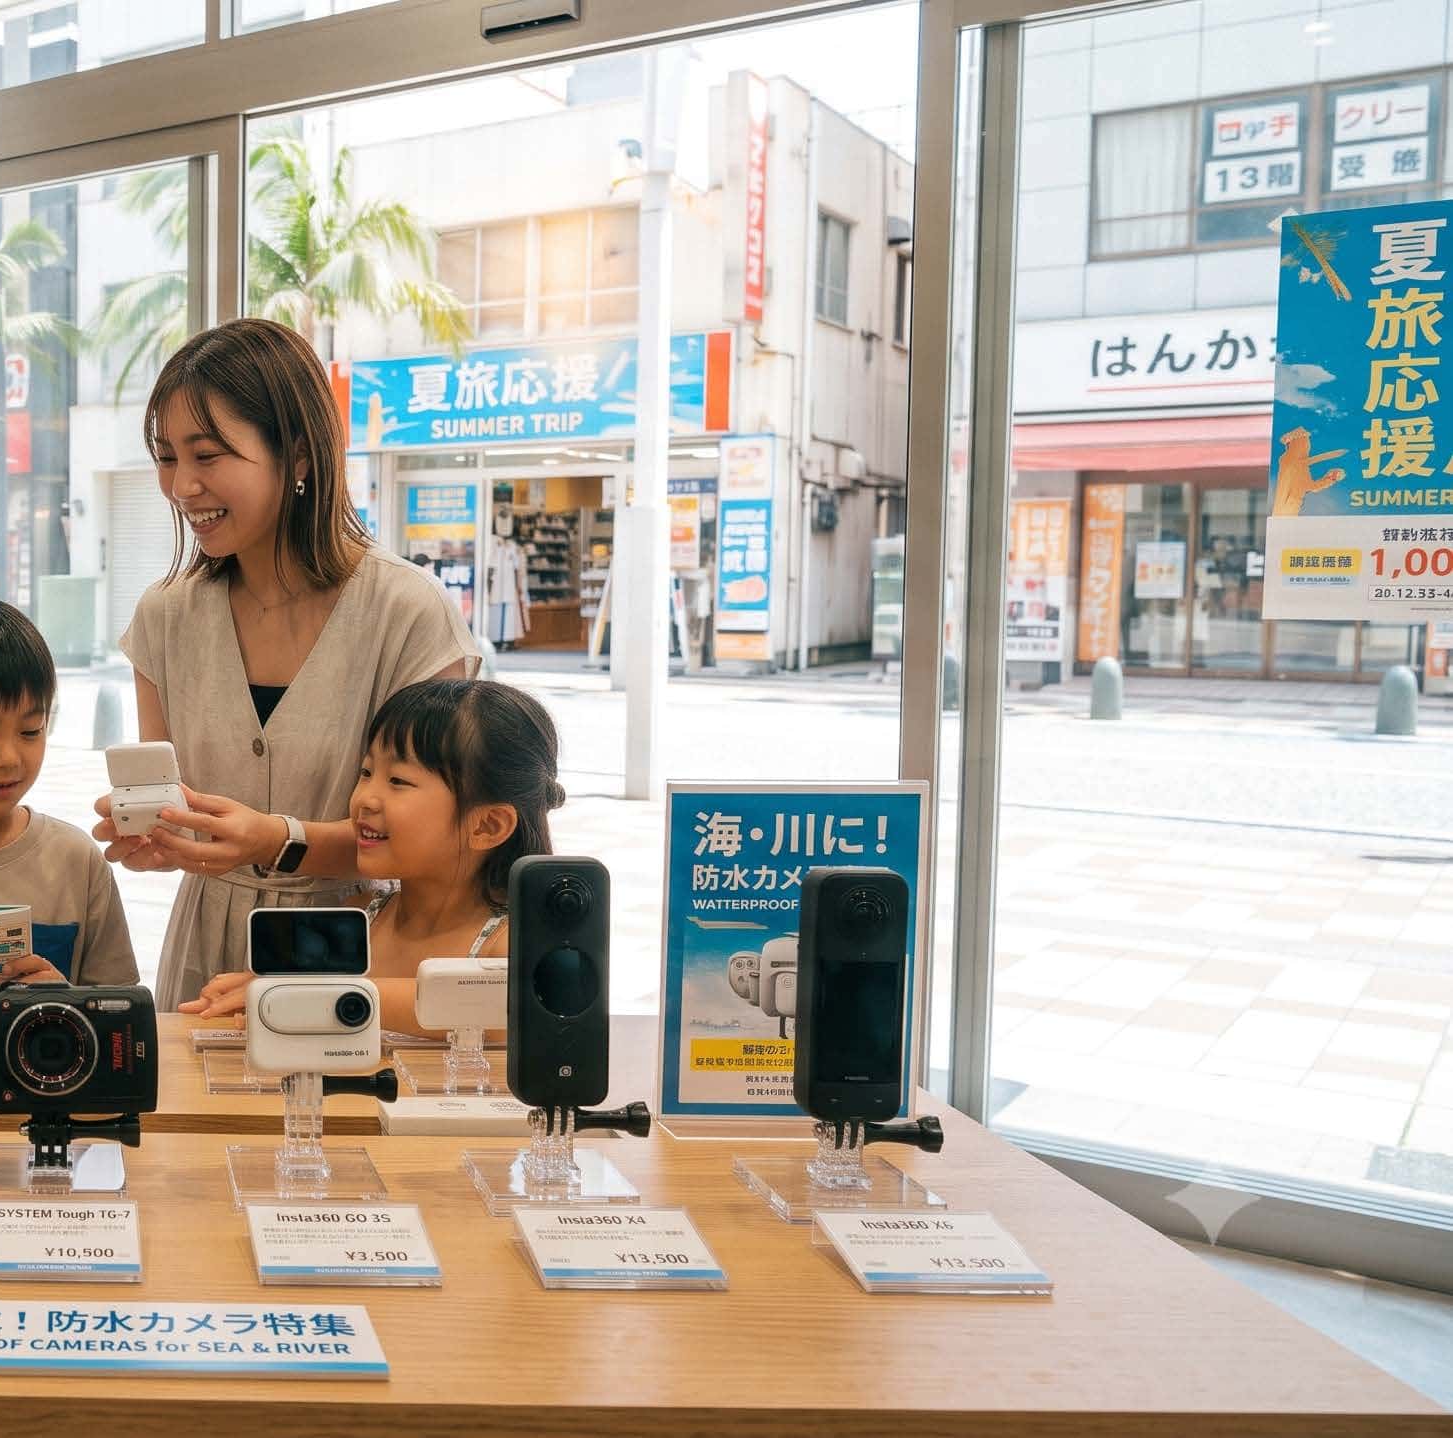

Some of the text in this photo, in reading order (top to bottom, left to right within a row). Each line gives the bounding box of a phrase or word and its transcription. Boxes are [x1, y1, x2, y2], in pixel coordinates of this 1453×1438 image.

[1092, 329, 1276, 376] はんか
[1361, 218, 1447, 478] 夏旅応援
[408, 354, 599, 413] 夏旅応援
[431, 412, 583, 439] SUMMER TRIP
[1350, 489, 1453, 507] SUMMER
[57, 1210, 95, 1221] Tough
[98, 1210, 130, 1219] TG-7
[276, 1212, 391, 1223] Insta360 GO 3S
[557, 1215, 646, 1225] Insta360 X4
[861, 1219, 955, 1230] Insta360 X6
[45, 1247, 114, 1259] ¥10,500
[346, 1251, 408, 1262] ¥3,500
[614, 1252, 689, 1265] ¥13,500
[30, 1338, 147, 1352] CAMERAS
[156, 1340, 190, 1353] for
[198, 1341, 244, 1353] SEA
[253, 1341, 270, 1354] &
[277, 1342, 352, 1355] RIVER
